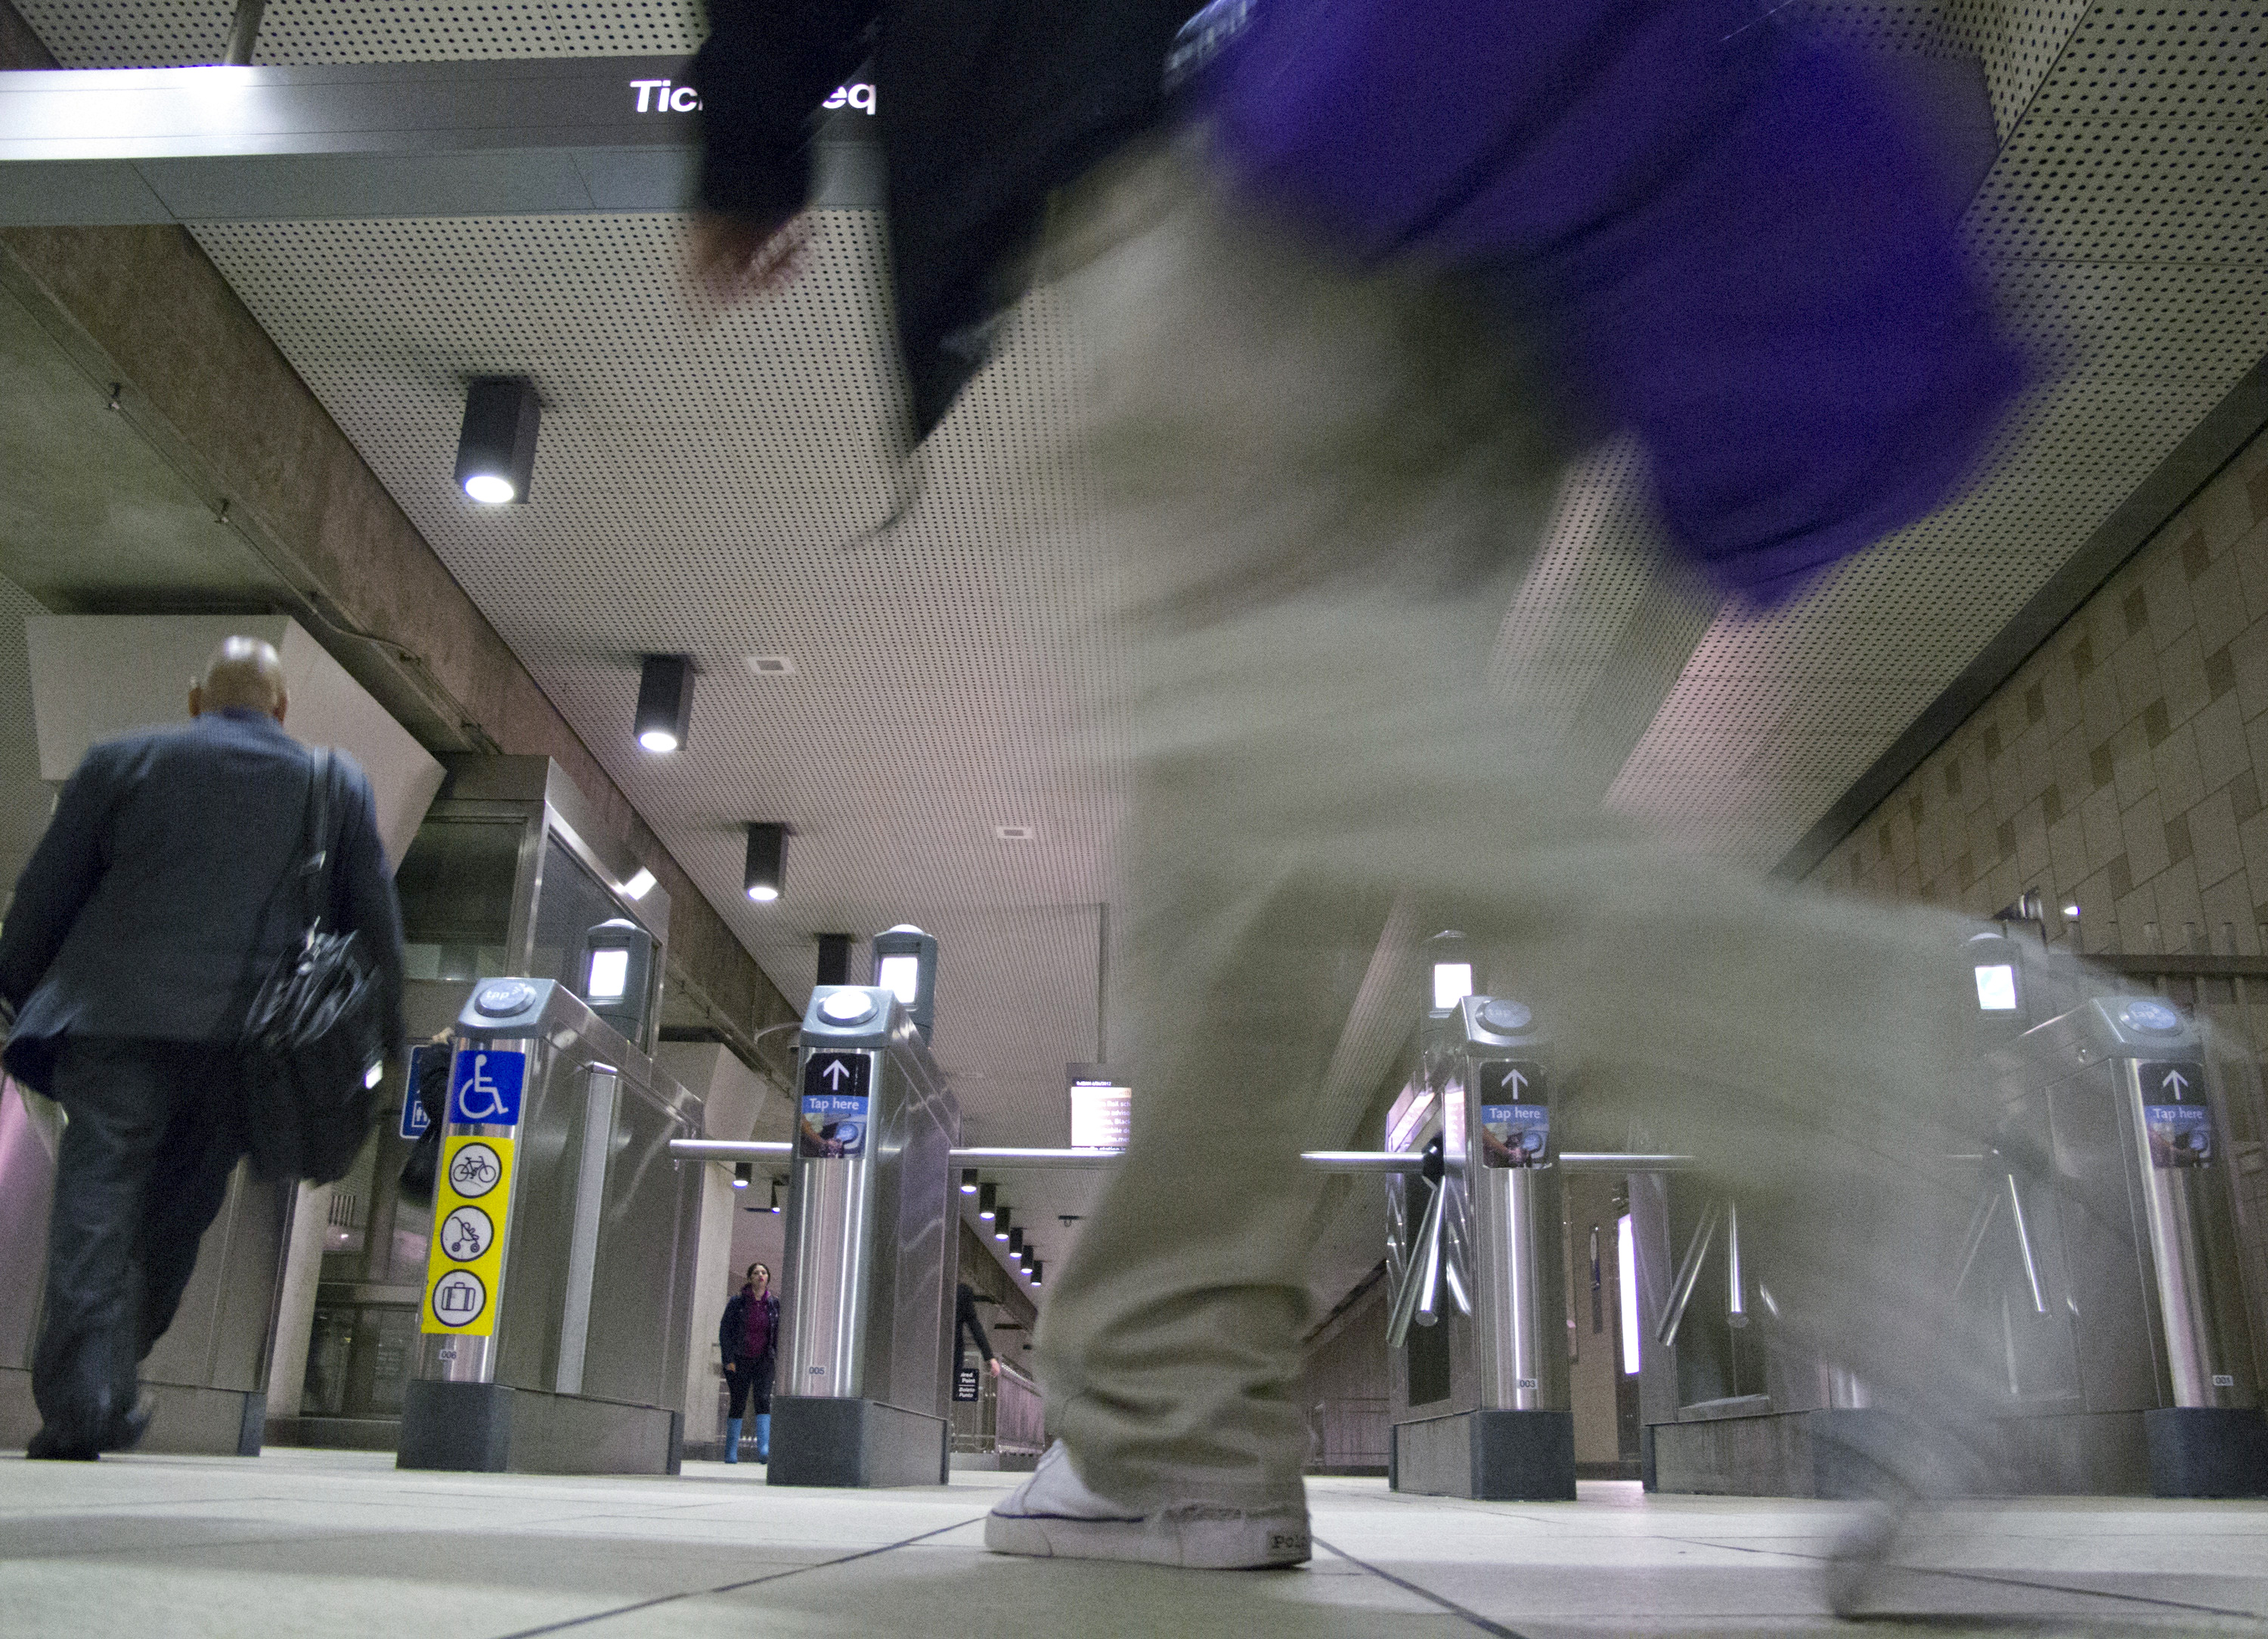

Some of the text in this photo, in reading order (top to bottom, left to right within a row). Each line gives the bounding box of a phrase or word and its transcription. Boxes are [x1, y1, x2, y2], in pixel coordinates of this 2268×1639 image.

[630, 80, 703, 112] Tic
[486, 990, 510, 999] tap
[810, 1098, 860, 1111] Tap here
[1489, 1106, 1541, 1121] Tap here
[2152, 1107, 2203, 1120] Tap here
[442, 1350, 457, 1359] 006
[809, 1366, 825, 1374] 005
